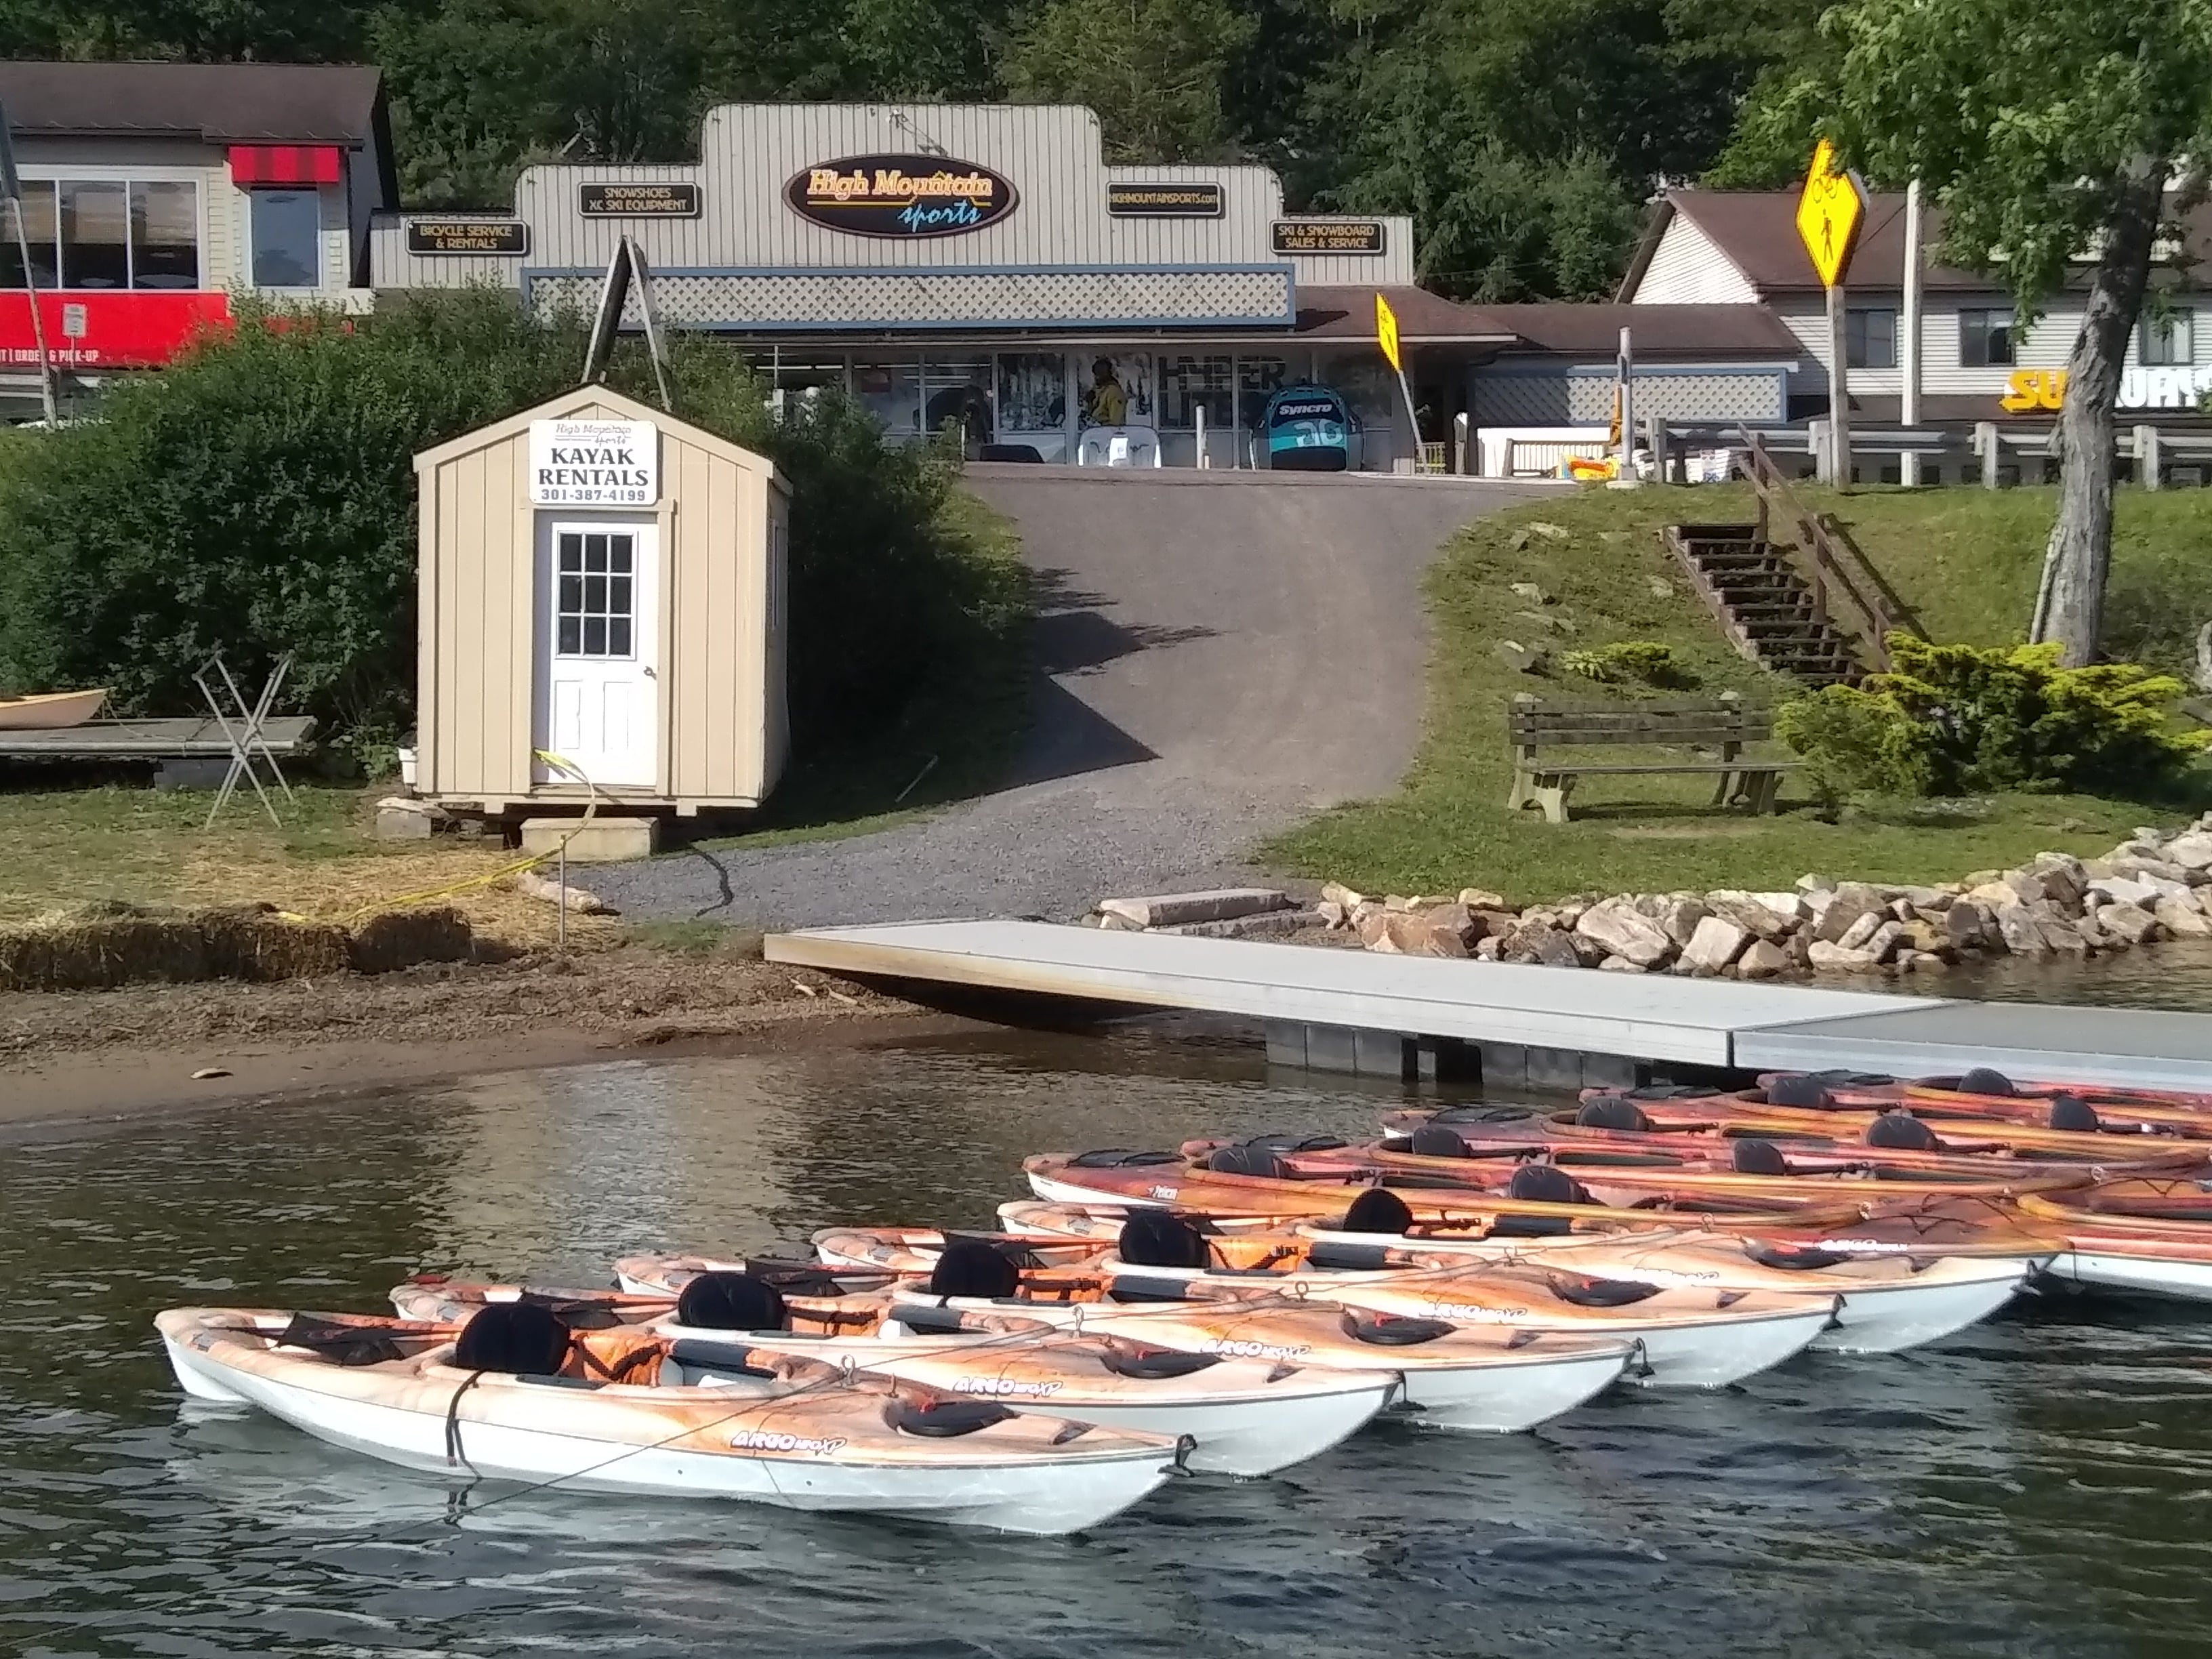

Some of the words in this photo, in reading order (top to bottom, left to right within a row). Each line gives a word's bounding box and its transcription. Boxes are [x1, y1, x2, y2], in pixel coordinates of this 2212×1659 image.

[806, 169, 869, 201] High
[872, 169, 992, 197] Mountain
[604, 187, 672, 199] SNOWSHOES
[589, 199, 603, 211] XC
[605, 199, 623, 211] SKI
[626, 199, 687, 211] EQUIPMENT
[897, 199, 982, 233] sports
[419, 225, 464, 237] BICYCLE
[466, 225, 513, 237] SERVICE
[1277, 225, 1295, 237] SKI
[1296, 225, 1305, 237] &
[1307, 225, 1374, 237] SNOWBOARD
[434, 238, 445, 249] &
[447, 238, 498, 249] RENTALS
[1285, 237, 1316, 249] SALES
[1317, 237, 1326, 249] &
[1327, 237, 1369, 249] SERVICE
[1279, 404, 1333, 415] Syncro
[551, 448, 635, 465] KAYAK
[539, 468, 649, 487] RENTALS
[541, 489, 646, 501] 301-387-4199
[731, 1430, 796, 1452] ARGO
